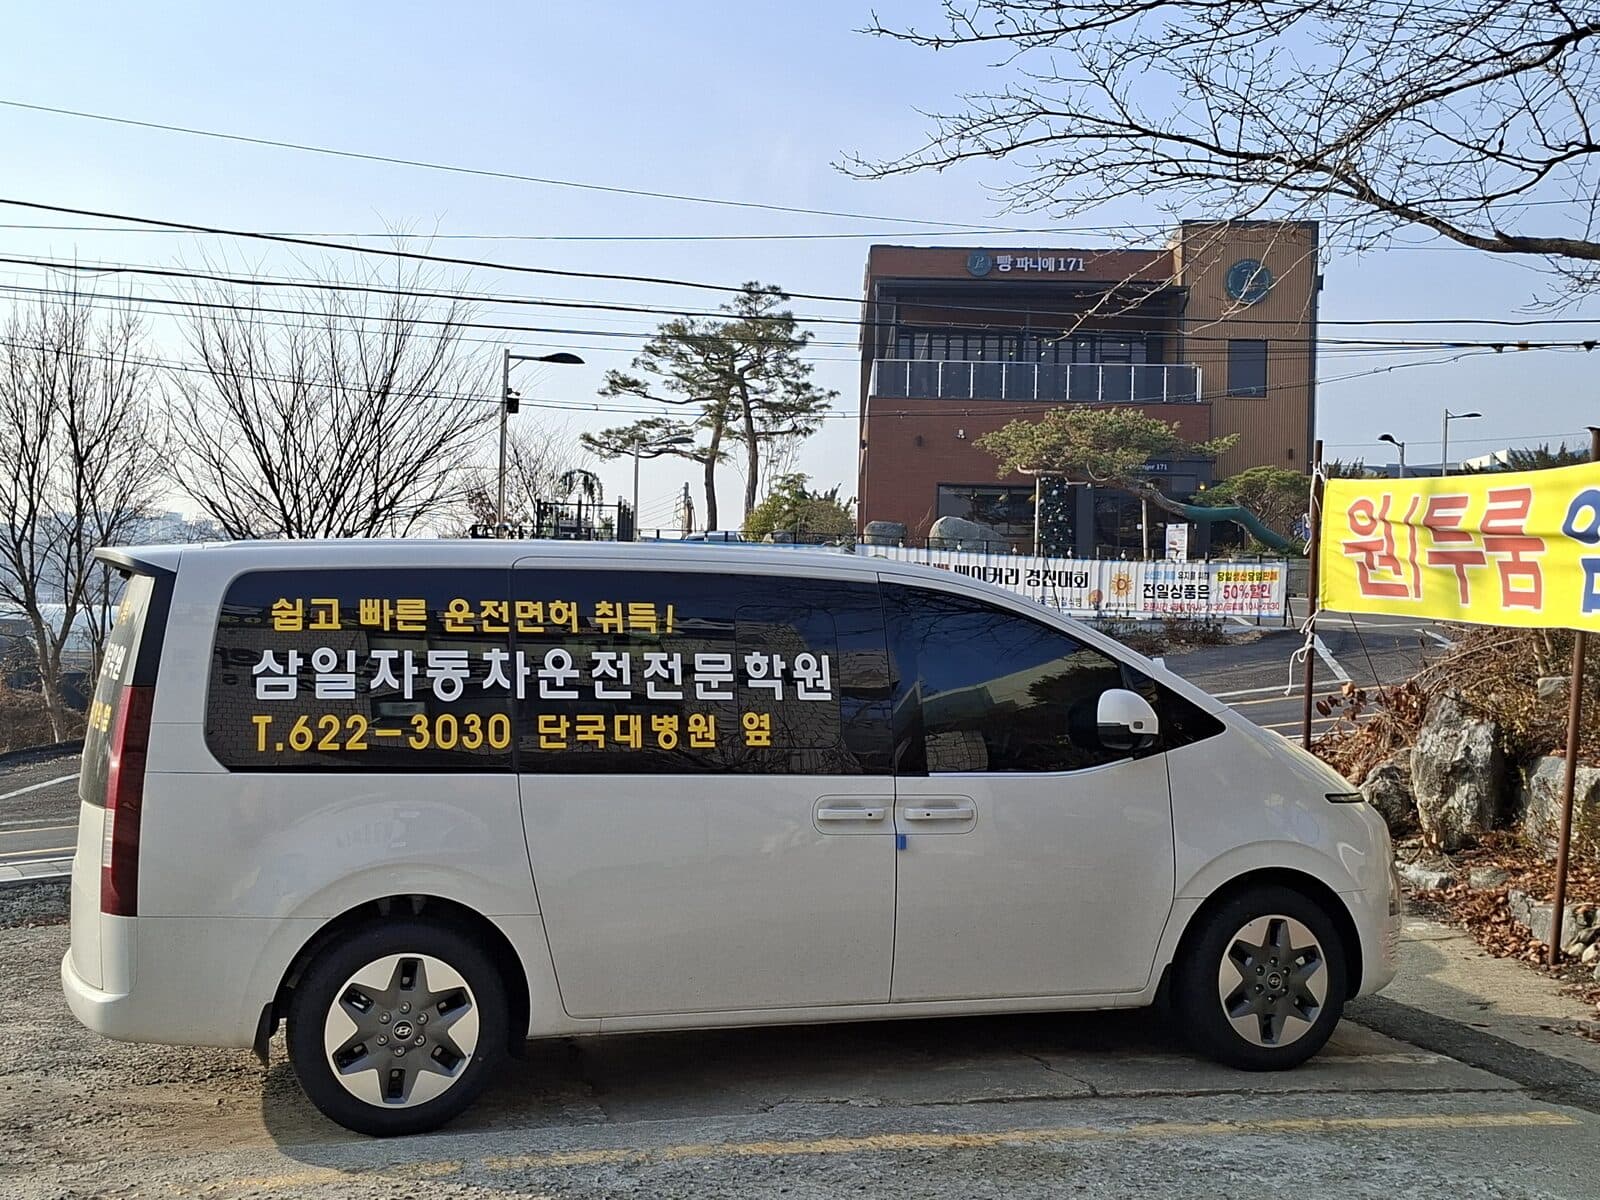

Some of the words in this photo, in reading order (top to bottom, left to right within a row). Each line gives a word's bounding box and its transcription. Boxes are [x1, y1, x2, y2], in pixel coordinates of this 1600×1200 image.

[996, 255, 1014, 272] 빵
[1016, 256, 1055, 272] 파니에
[1058, 257, 1085, 272] 171
[1025, 569, 1089, 589] 경진대회
[1143, 584, 1210, 599] 전일상품은
[272, 598, 342, 632] 쉽고
[359, 598, 427, 632] 빠른
[443, 598, 579, 634] 운전면허
[594, 601, 675, 635] 취득!
[251, 646, 833, 702] 삼일자동차운전전문학원
[252, 713, 511, 752] T.622-3030
[537, 712, 717, 750] 단국대병원
[744, 712, 772, 749] 옆
